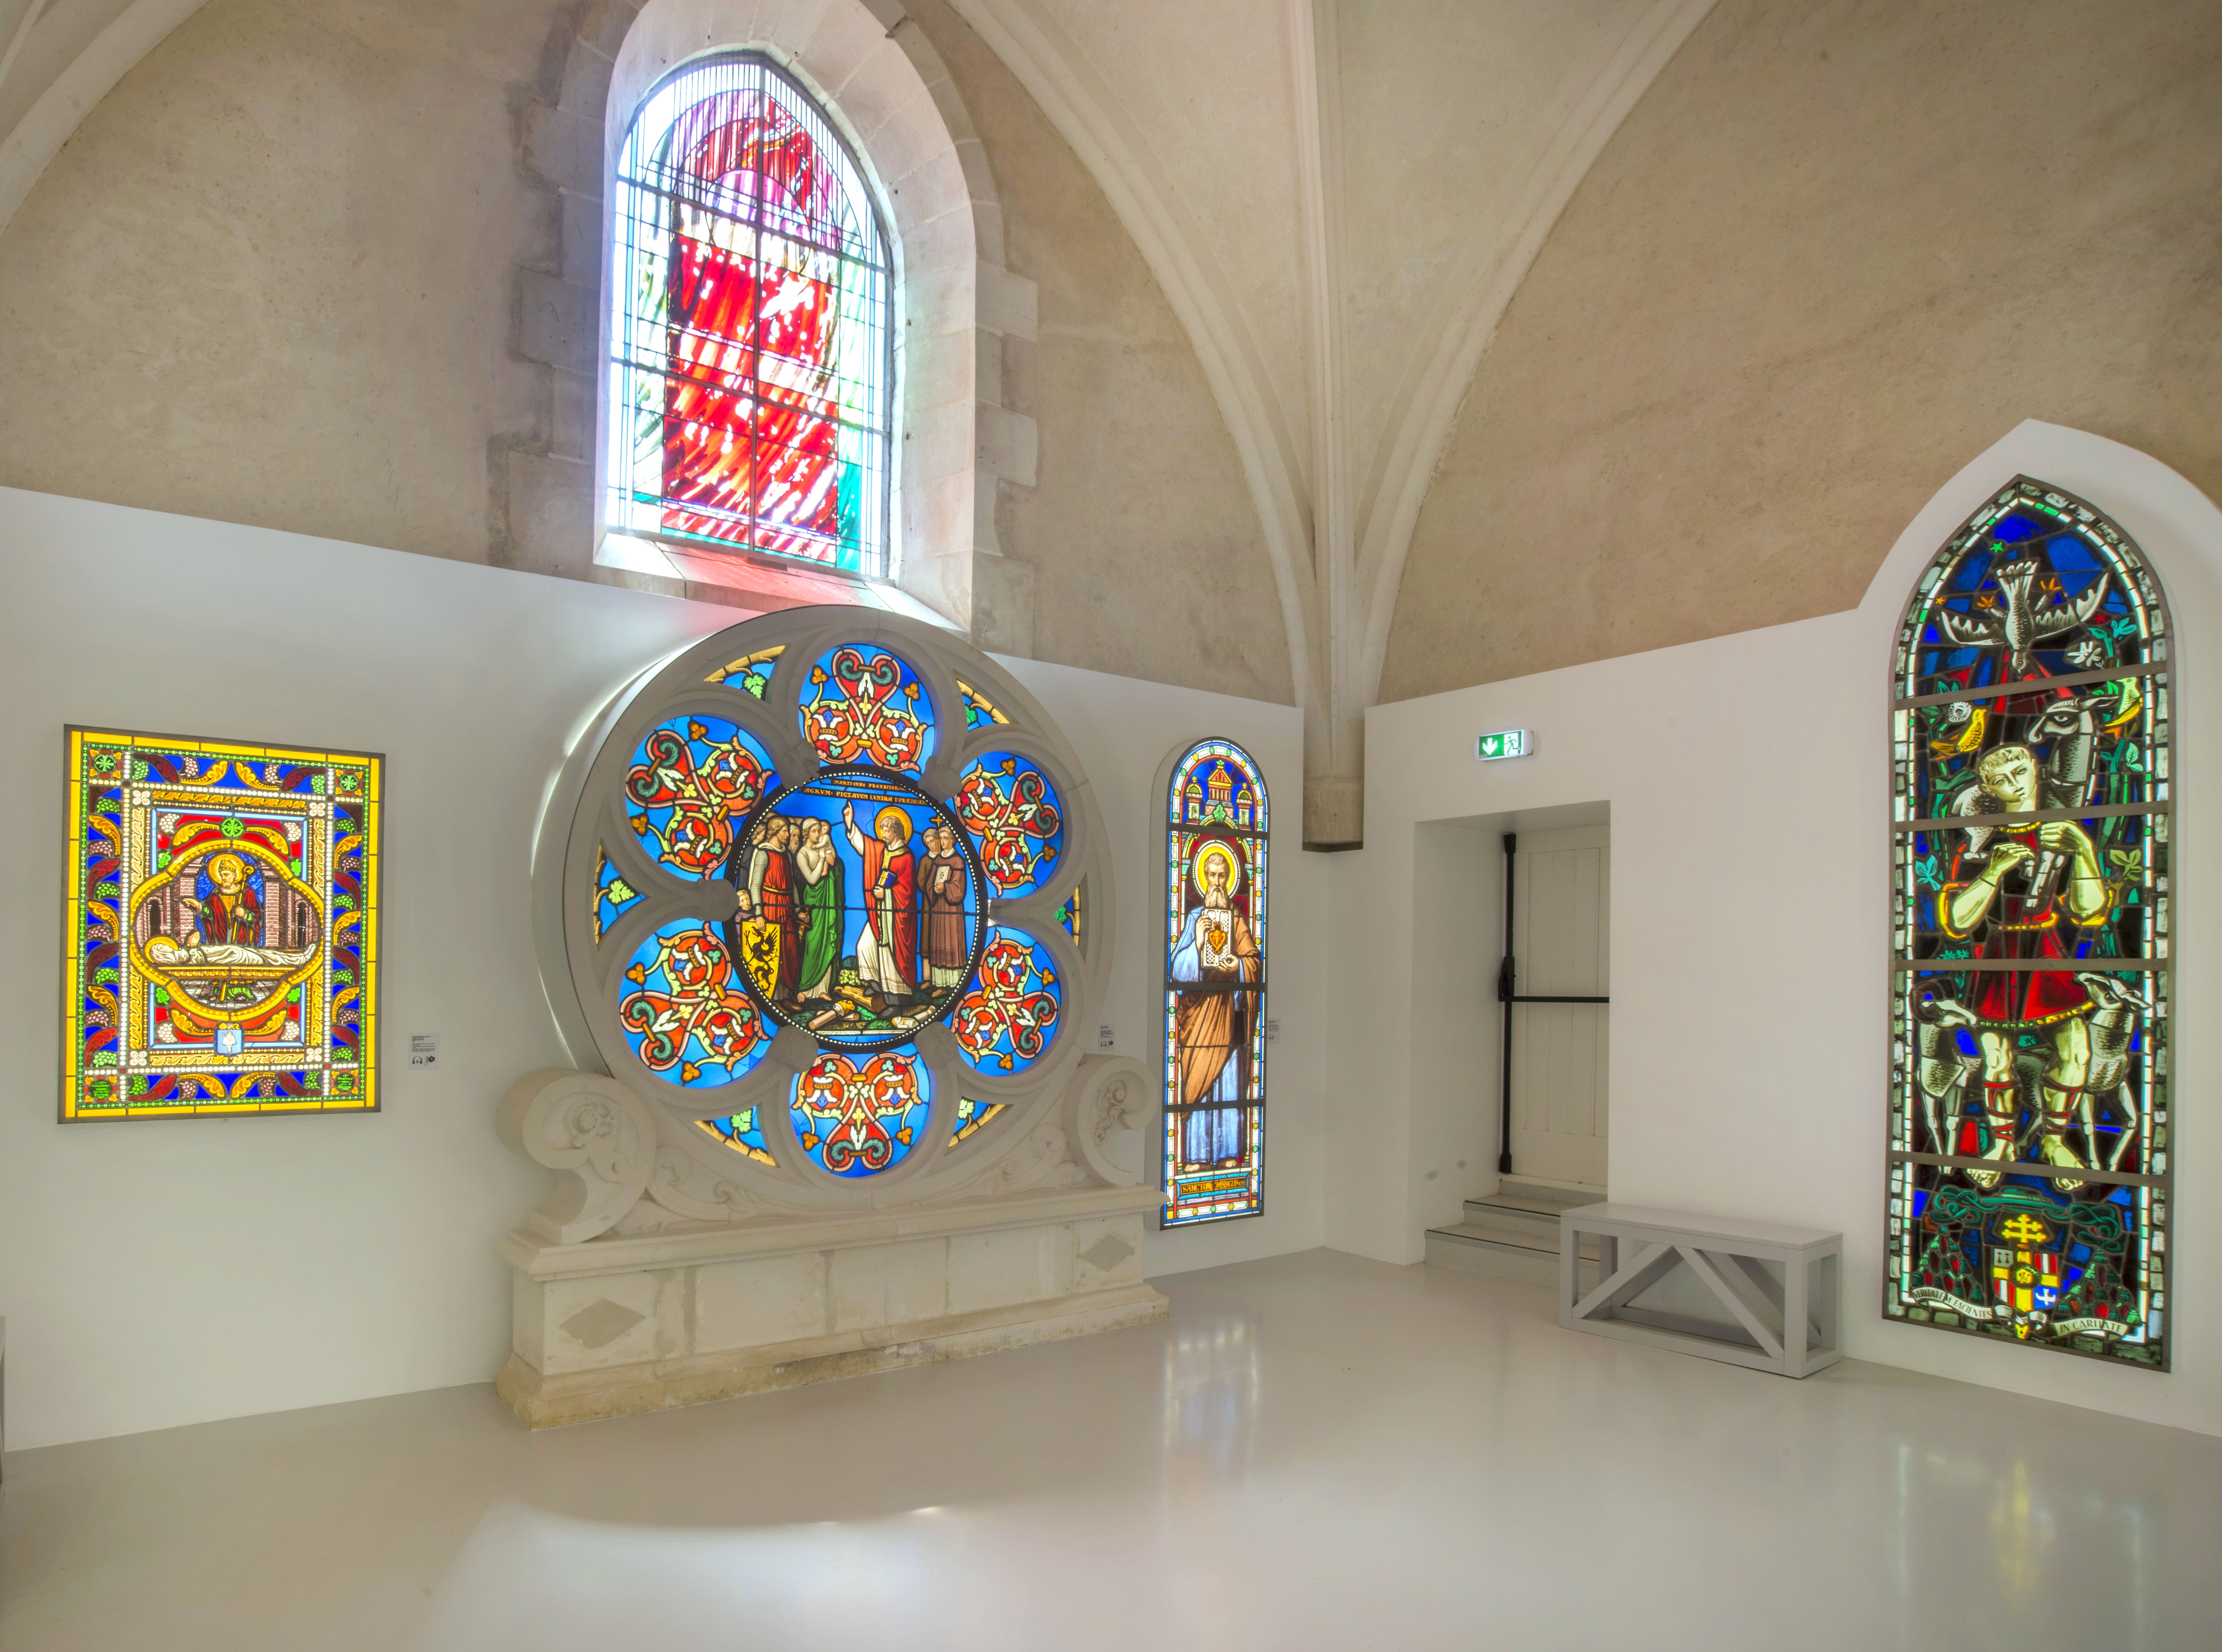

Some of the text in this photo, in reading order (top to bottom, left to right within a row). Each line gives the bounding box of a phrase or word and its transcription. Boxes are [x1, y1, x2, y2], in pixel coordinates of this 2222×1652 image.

[1913, 1289, 1993, 1318] VERITATEM FACIENTES
[2059, 1319, 2123, 1333] IN CARITATE
